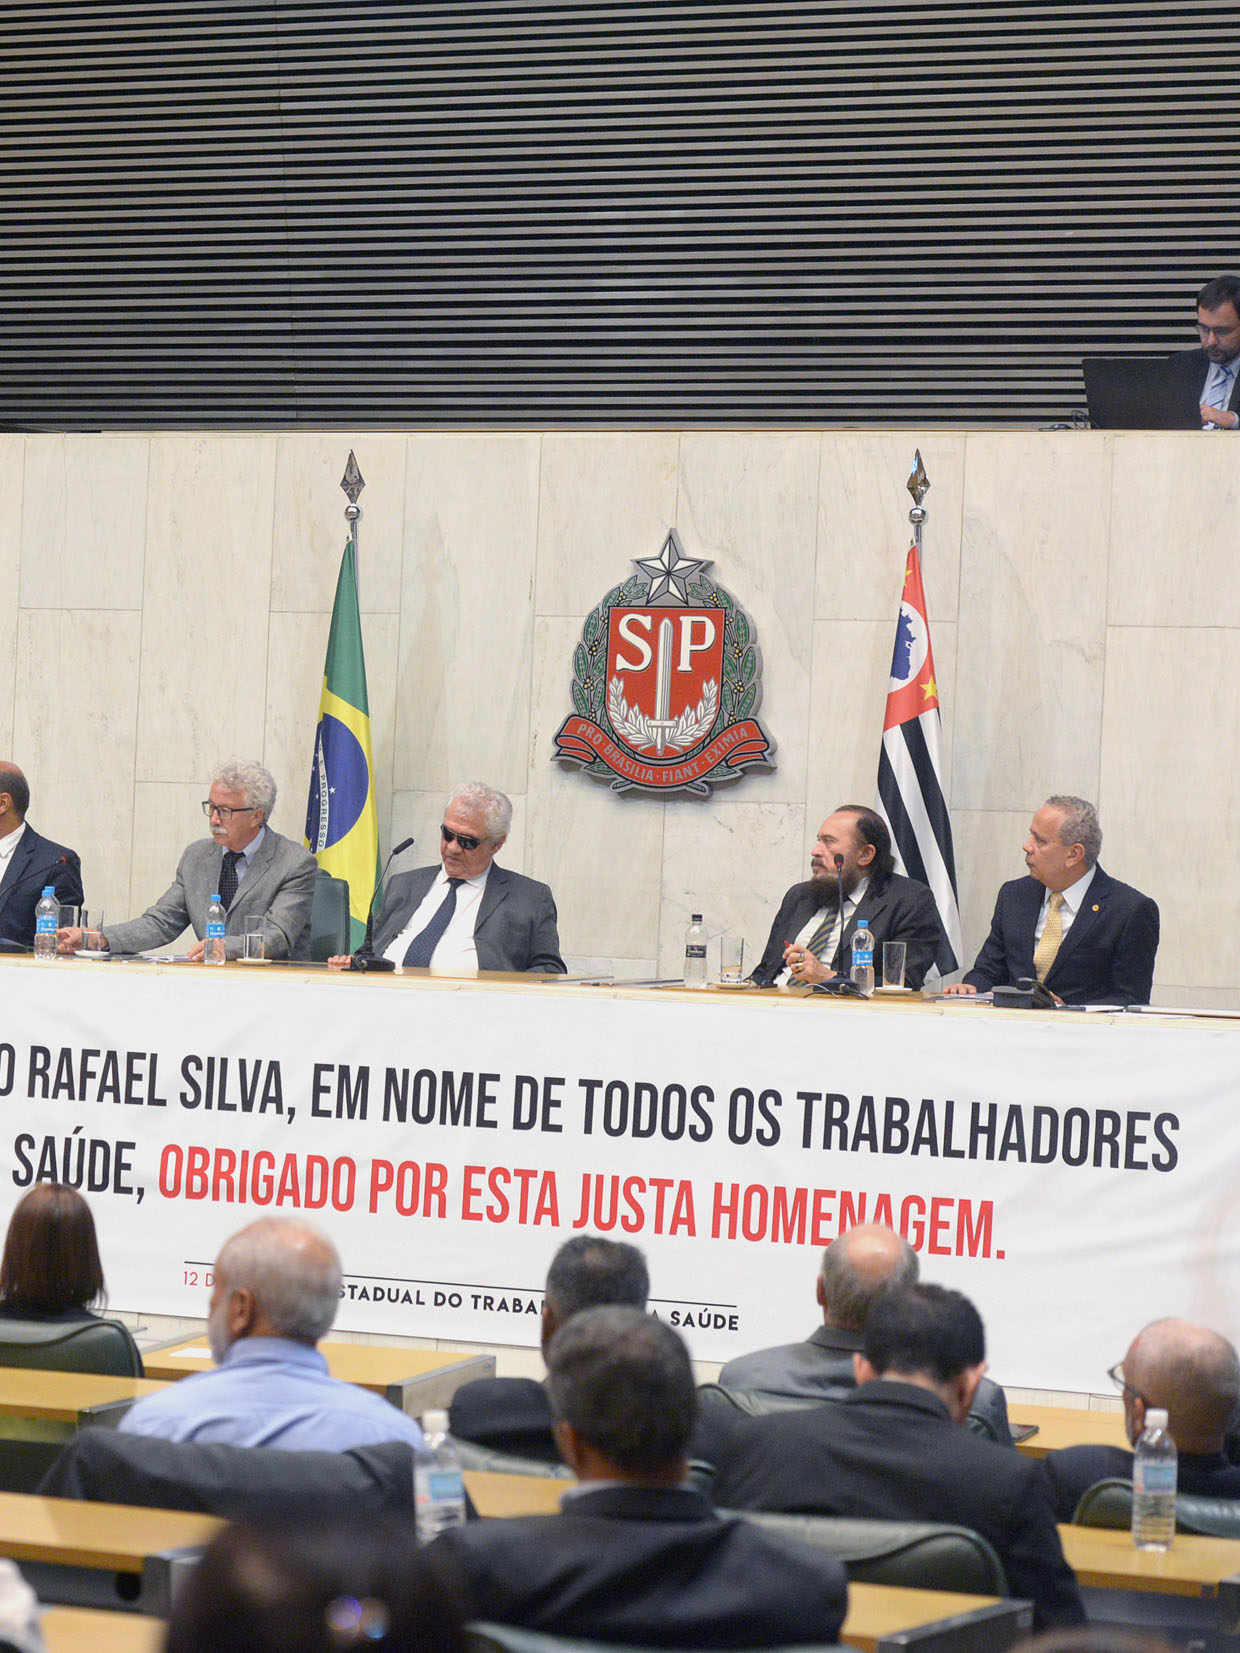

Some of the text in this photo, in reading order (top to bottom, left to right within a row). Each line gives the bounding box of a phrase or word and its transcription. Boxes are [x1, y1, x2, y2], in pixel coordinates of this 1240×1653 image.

[577, 723, 749, 782] PRO BRASILIA FIANT EXIMIA
[319, 775, 328, 848] PROGRESSO
[27, 1046, 167, 1107] RAFAEL
[180, 1055, 296, 1125] SILVA,
[312, 1064, 370, 1121] EM
[383, 1068, 501, 1129] NOME
[513, 1076, 566, 1133] DE
[578, 1079, 715, 1143] TODOS
[728, 1088, 783, 1147] OS
[797, 1092, 1180, 1173] TRABALHADORES
[12, 1126, 145, 1205] SAÚDE,
[160, 1144, 357, 1212] OBRIGADO
[368, 1160, 449, 1219] POR
[462, 1166, 560, 1227] ESTA
[572, 1173, 697, 1237] JUSTA
[712, 1183, 1006, 1260] HOMENAGEM.
[184, 1271, 198, 1286] 12
[338, 1285, 425, 1306] STADUAL
[433, 1291, 463, 1309] DO
[670, 1307, 739, 1331] SAÚDE
